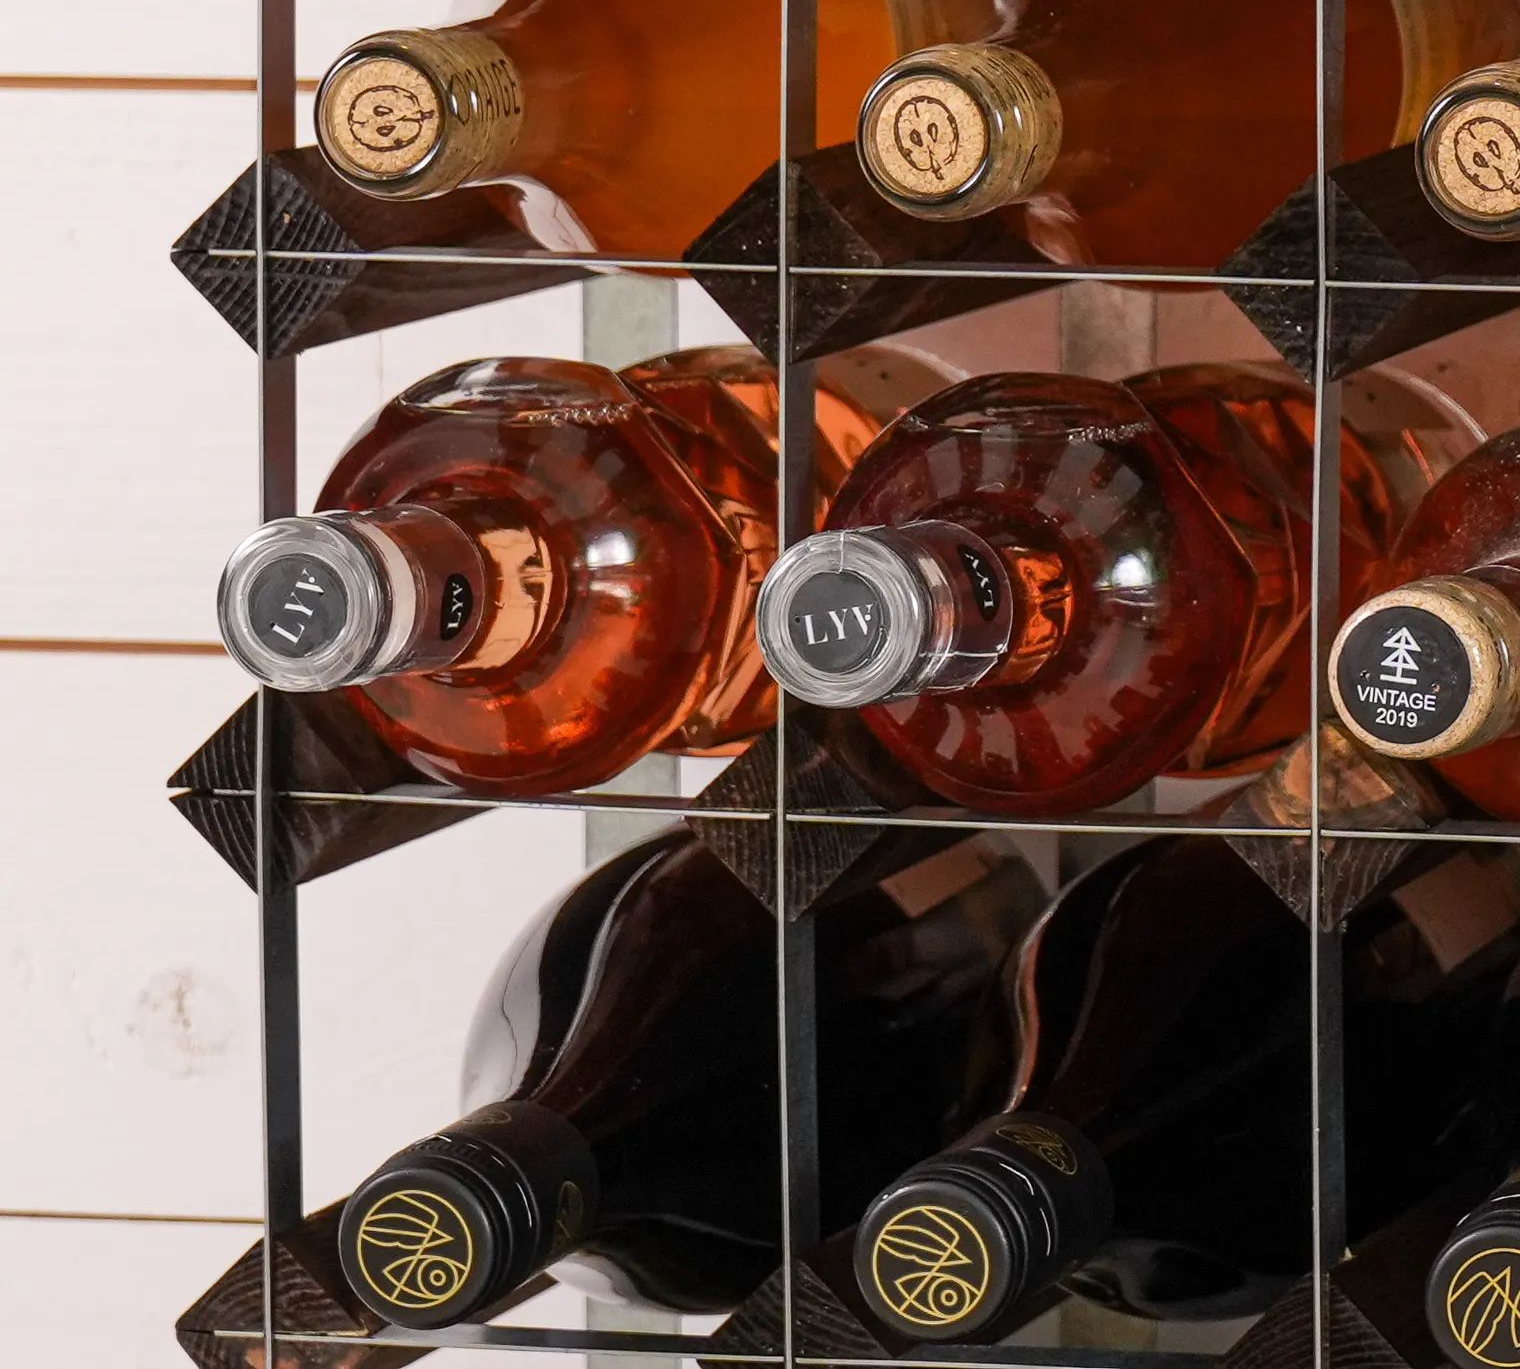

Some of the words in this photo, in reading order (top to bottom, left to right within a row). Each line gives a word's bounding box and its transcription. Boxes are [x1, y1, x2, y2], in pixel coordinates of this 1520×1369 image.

[270, 567, 325, 644] LYV
[445, 581, 465, 630] LYV
[803, 602, 874, 646] LYV
[1356, 683, 1437, 712] VINTAGE
[1375, 707, 1418, 728] 2019
